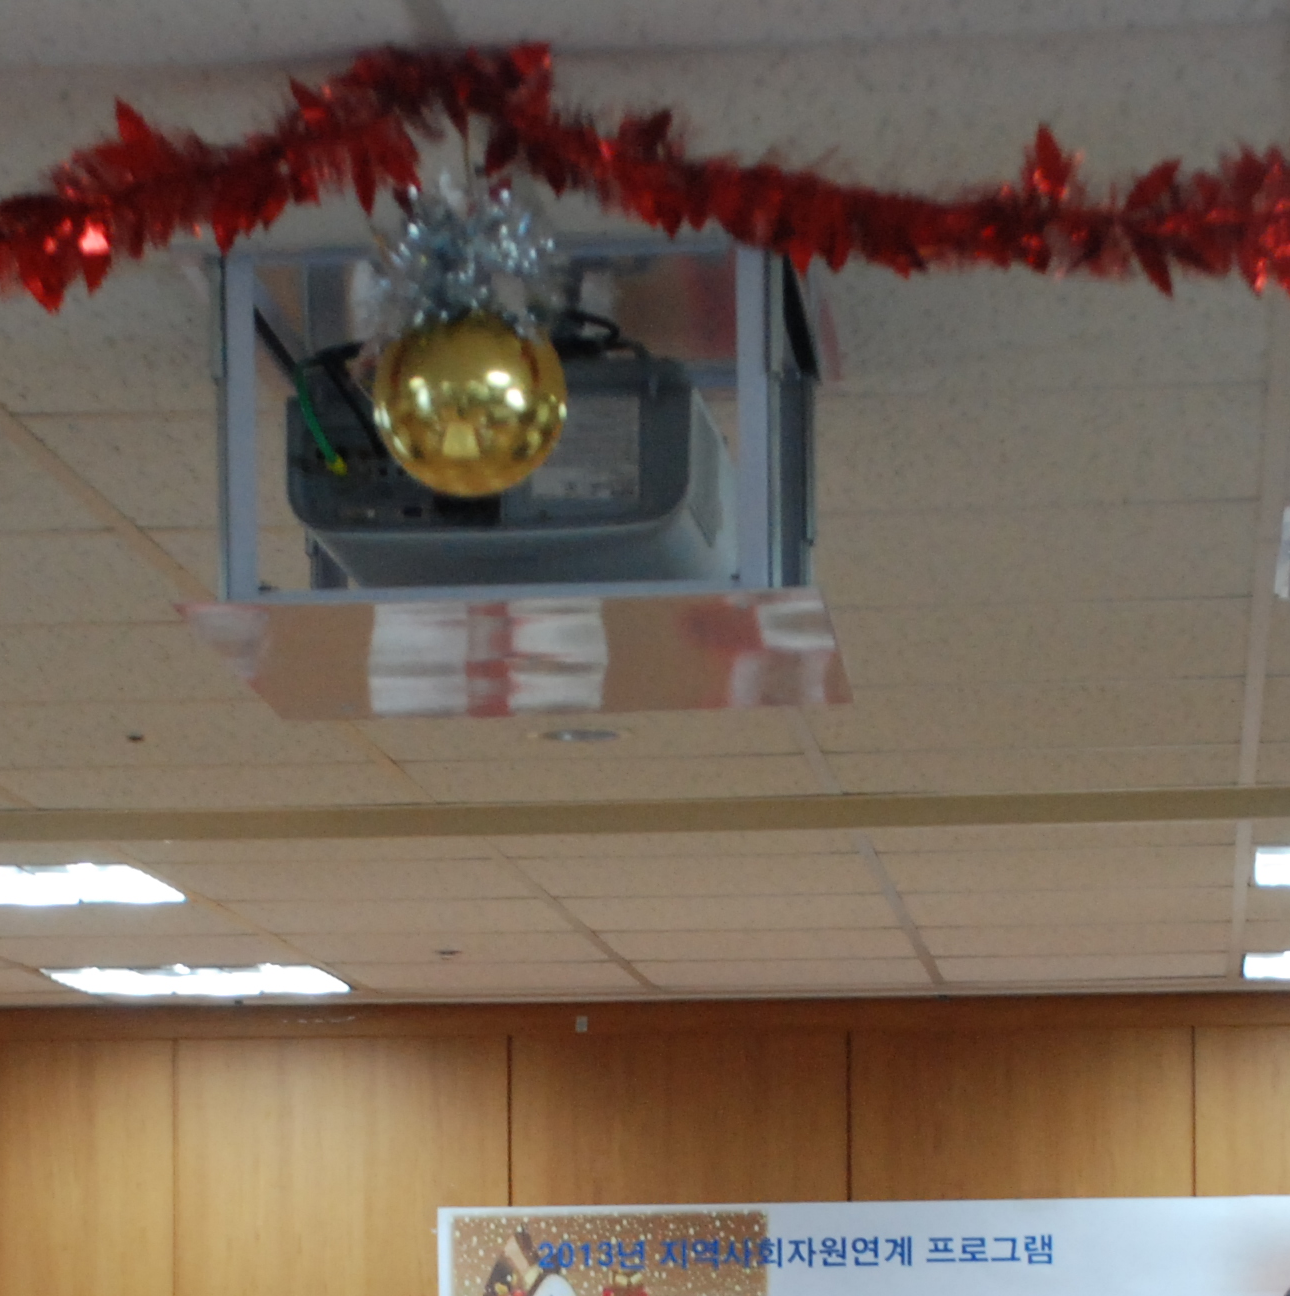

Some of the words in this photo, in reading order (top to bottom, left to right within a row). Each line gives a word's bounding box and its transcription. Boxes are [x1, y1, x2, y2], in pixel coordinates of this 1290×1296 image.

[537, 1238, 645, 1270] 2013년
[660, 1232, 912, 1268] 지역사회자원연계
[925, 1232, 1054, 1265] 프로그램
